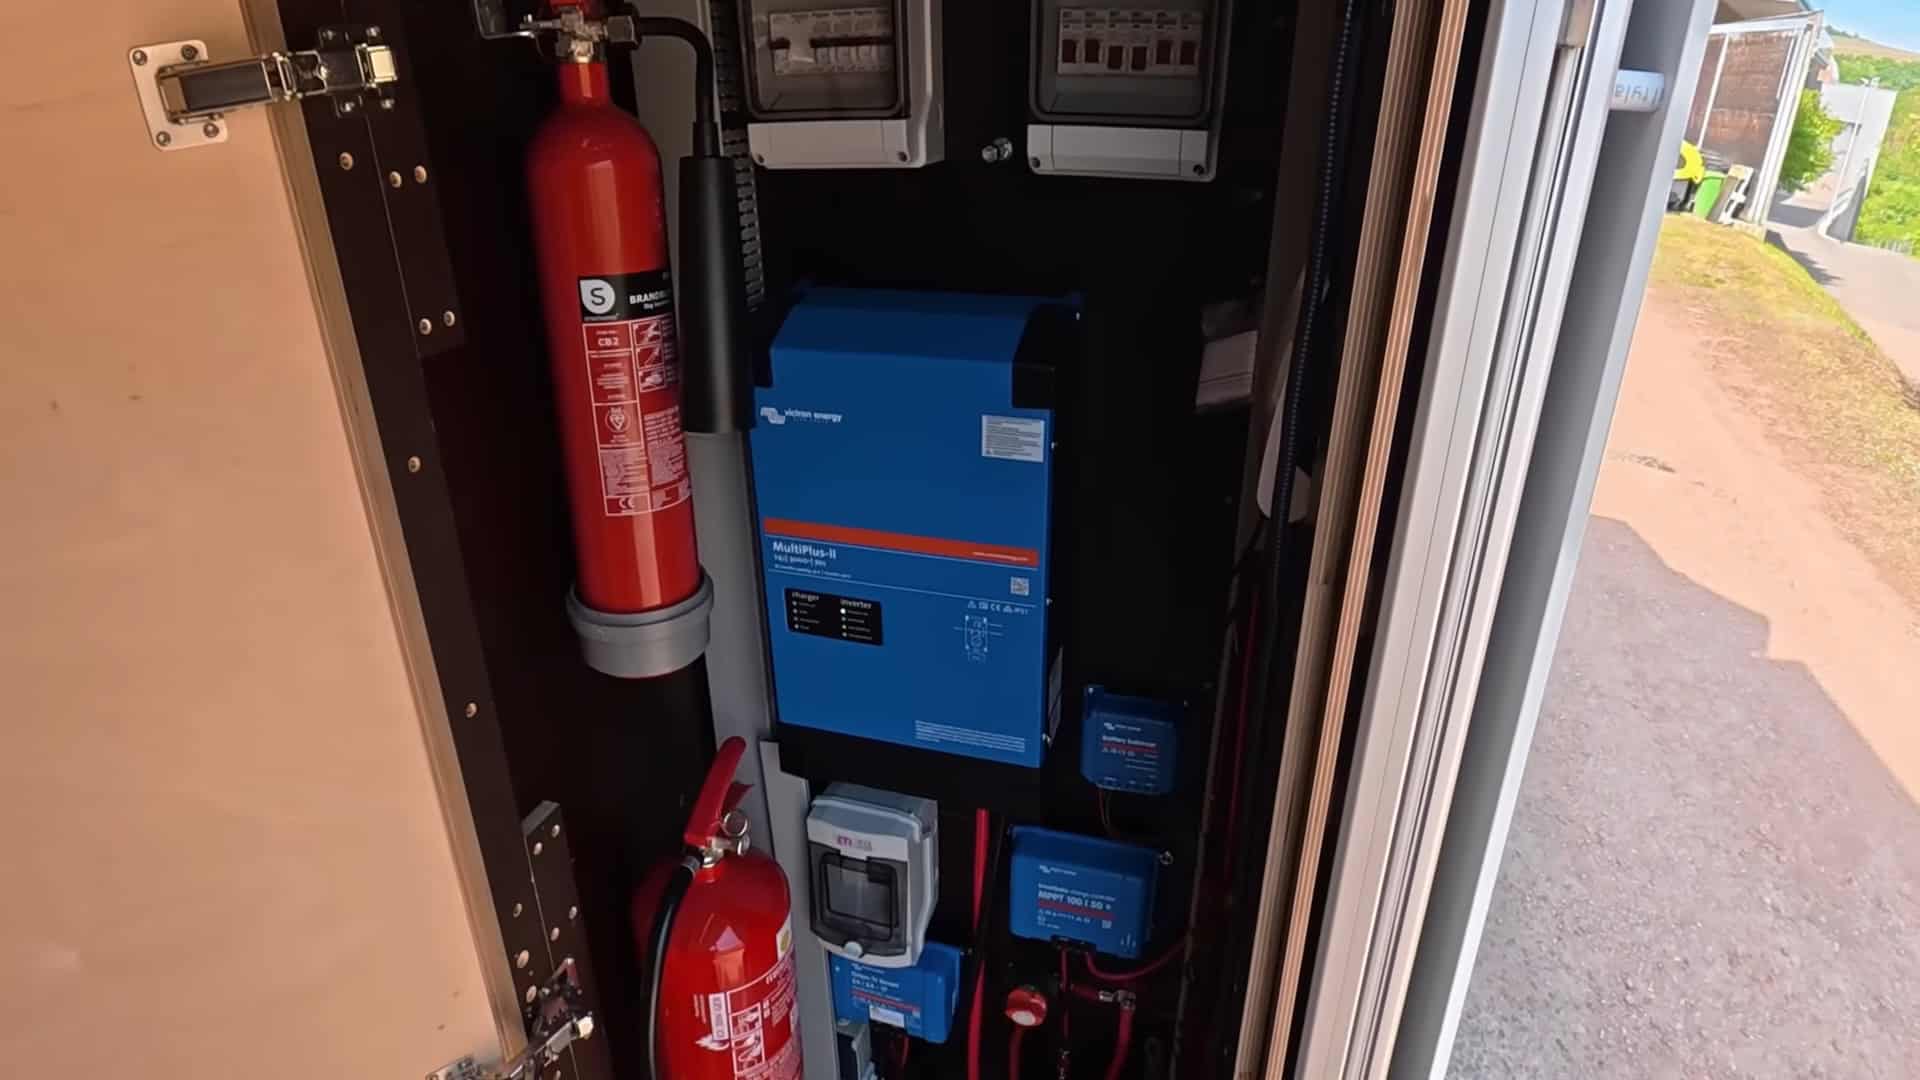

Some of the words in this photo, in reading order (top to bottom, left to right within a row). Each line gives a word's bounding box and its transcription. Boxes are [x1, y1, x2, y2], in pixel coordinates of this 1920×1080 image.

[784, 407, 811, 418] victron
[813, 412, 843, 423] energy
[1038, 890, 1064, 903] MPPT
[1066, 895, 1083, 907] 100
